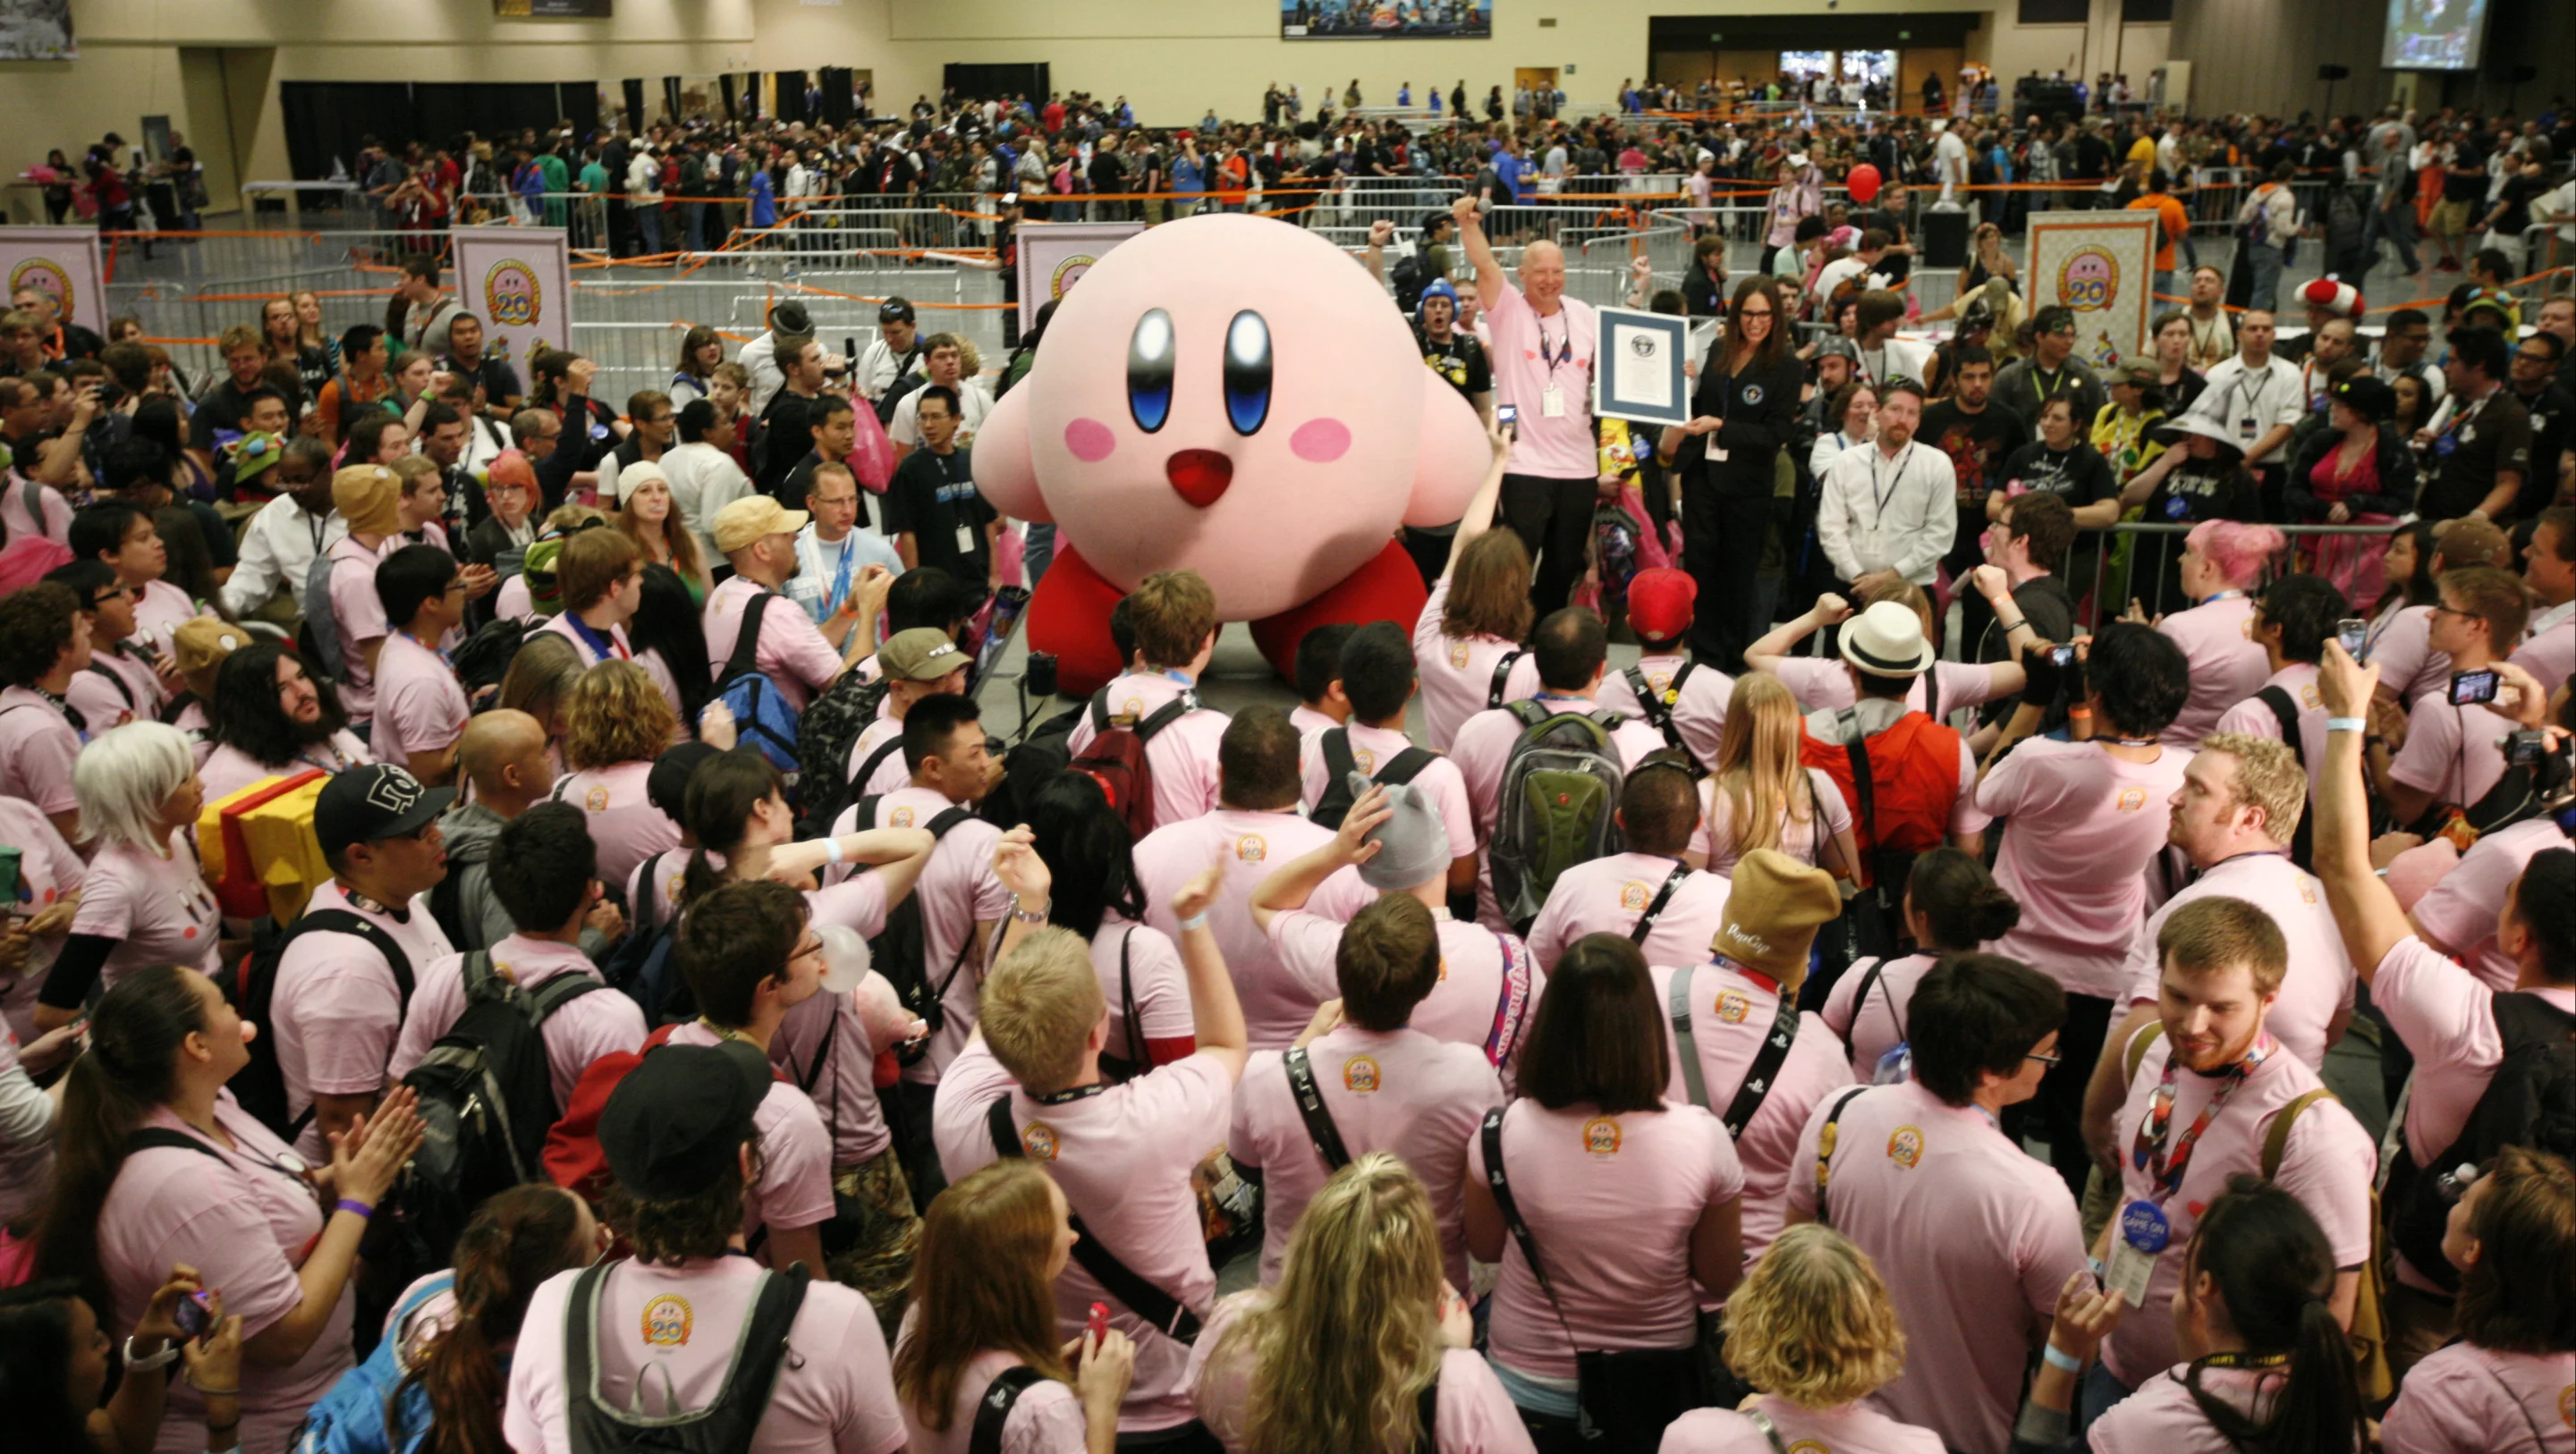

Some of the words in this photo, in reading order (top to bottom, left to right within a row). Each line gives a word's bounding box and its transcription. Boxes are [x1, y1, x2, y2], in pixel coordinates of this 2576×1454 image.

[2070, 279, 2106, 304] 20
[496, 292, 531, 319] 20
[1726, 923, 1771, 955] PopCap
[1721, 1002, 1741, 1019] 20
[1293, 1067, 1319, 1111] PS3
[1351, 1073, 1375, 1088] 20
[1029, 1141, 1054, 1158] 20
[1591, 1137, 1614, 1151] 20
[1893, 1143, 1915, 1162] 20
[2123, 1216, 2148, 1230] GAME
[2149, 1222, 2166, 1235] ON
[650, 1319, 683, 1340] 20
